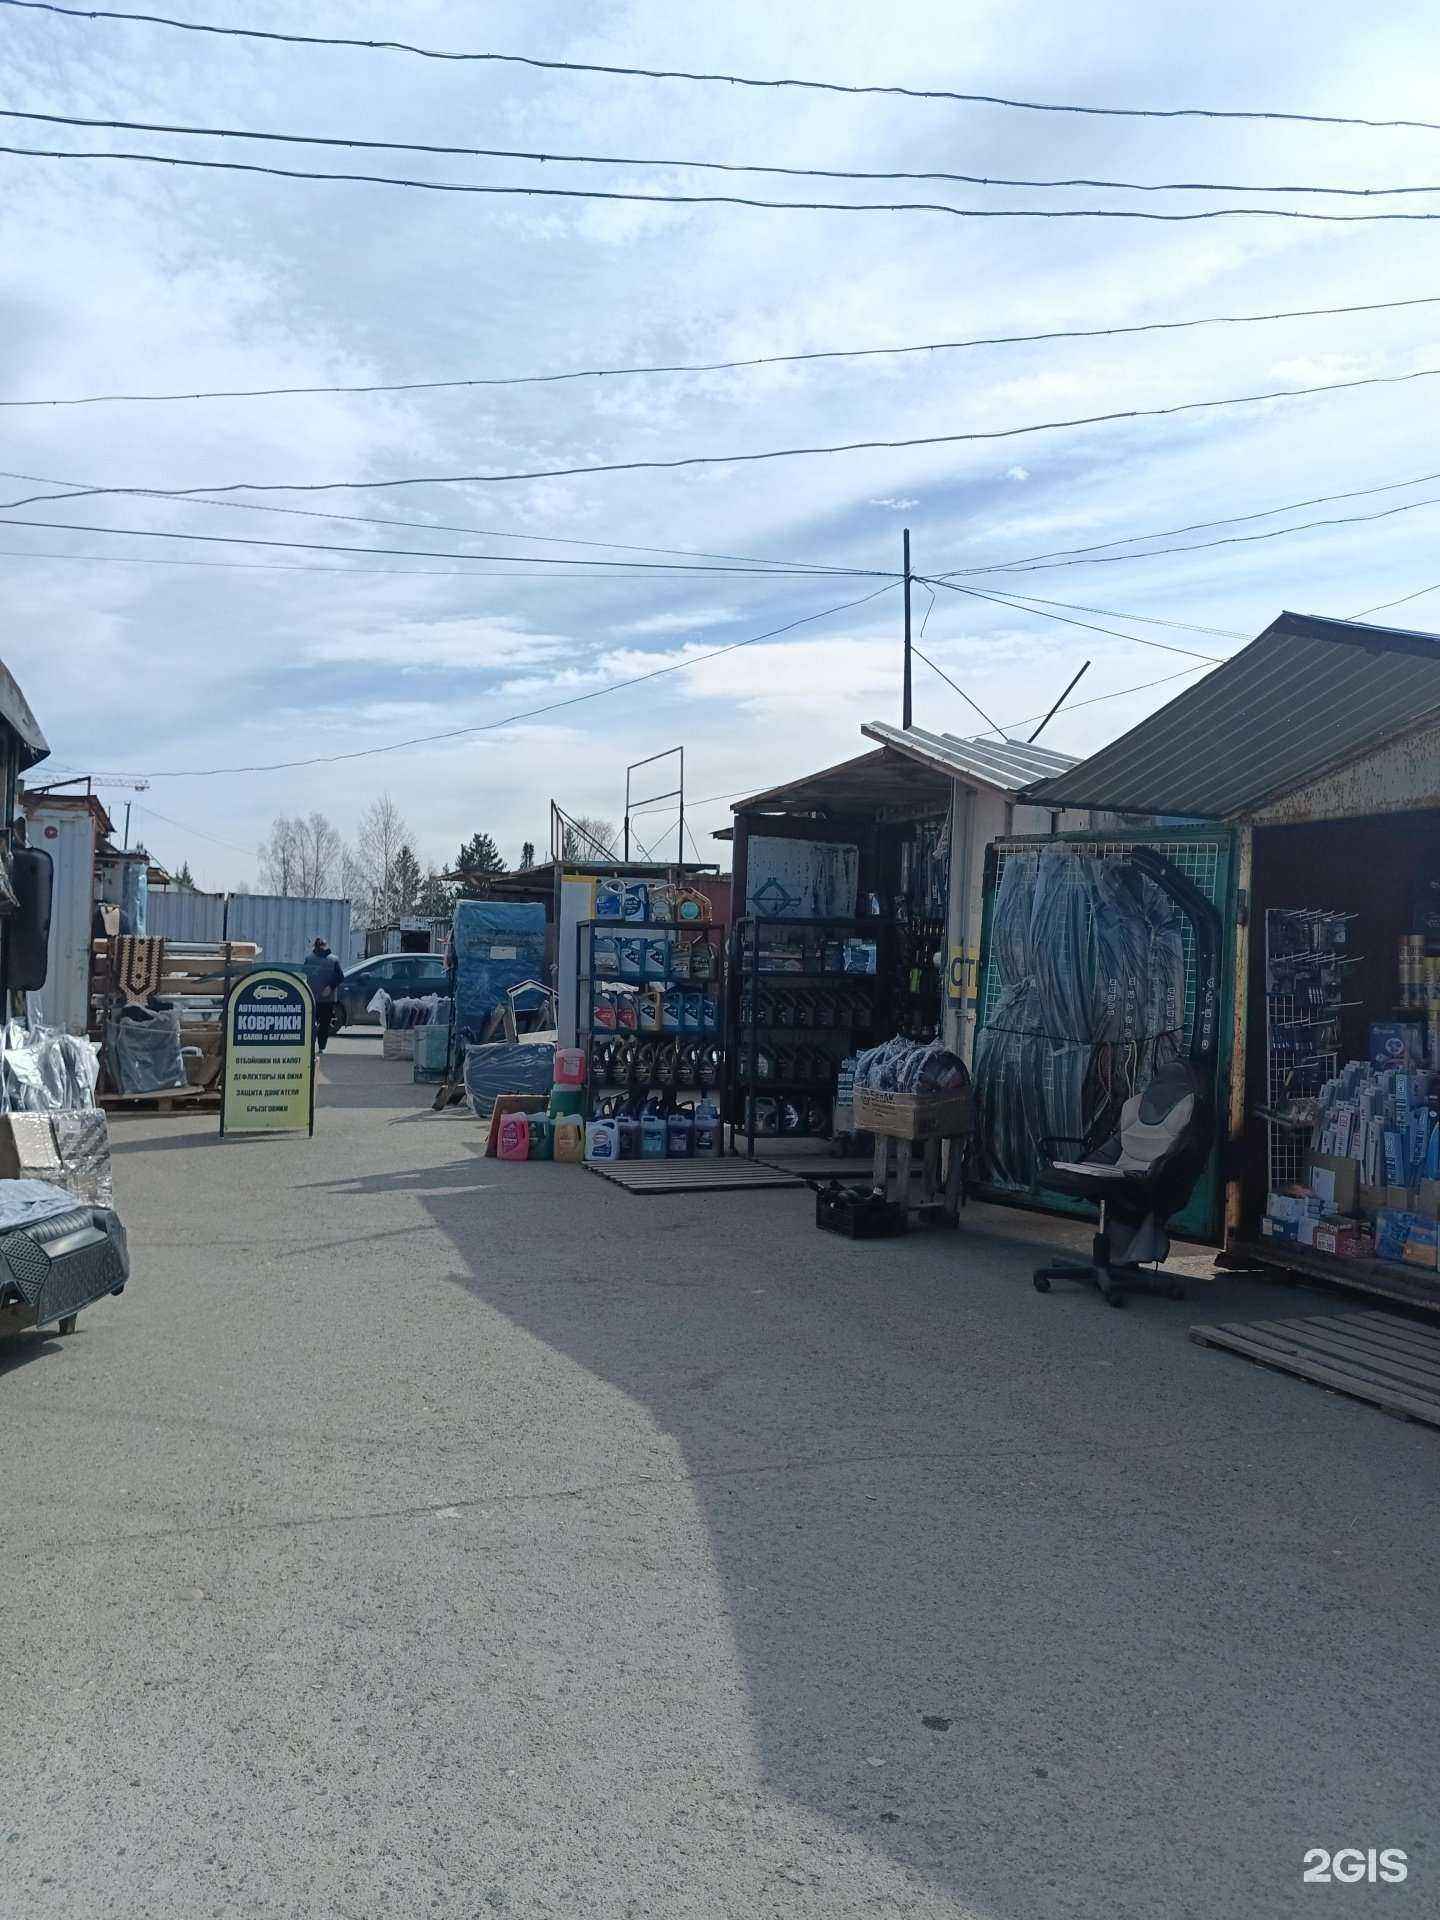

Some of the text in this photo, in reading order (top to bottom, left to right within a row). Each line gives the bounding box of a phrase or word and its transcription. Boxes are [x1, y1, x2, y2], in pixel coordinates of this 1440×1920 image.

[238, 1004, 302, 1013] АВТОМОБИЛЬНЫЕ
[238, 1015, 301, 1030] КОВРИКИ
[243, 1033, 263, 1041] САЛОН
[233, 1073, 276, 1081] ДЕФЛЕКТОРЫ
[277, 1073, 285, 1081] НА
[236, 1089, 299, 1098] ЗАЩИТА ДВИГАТЕЛЯ
